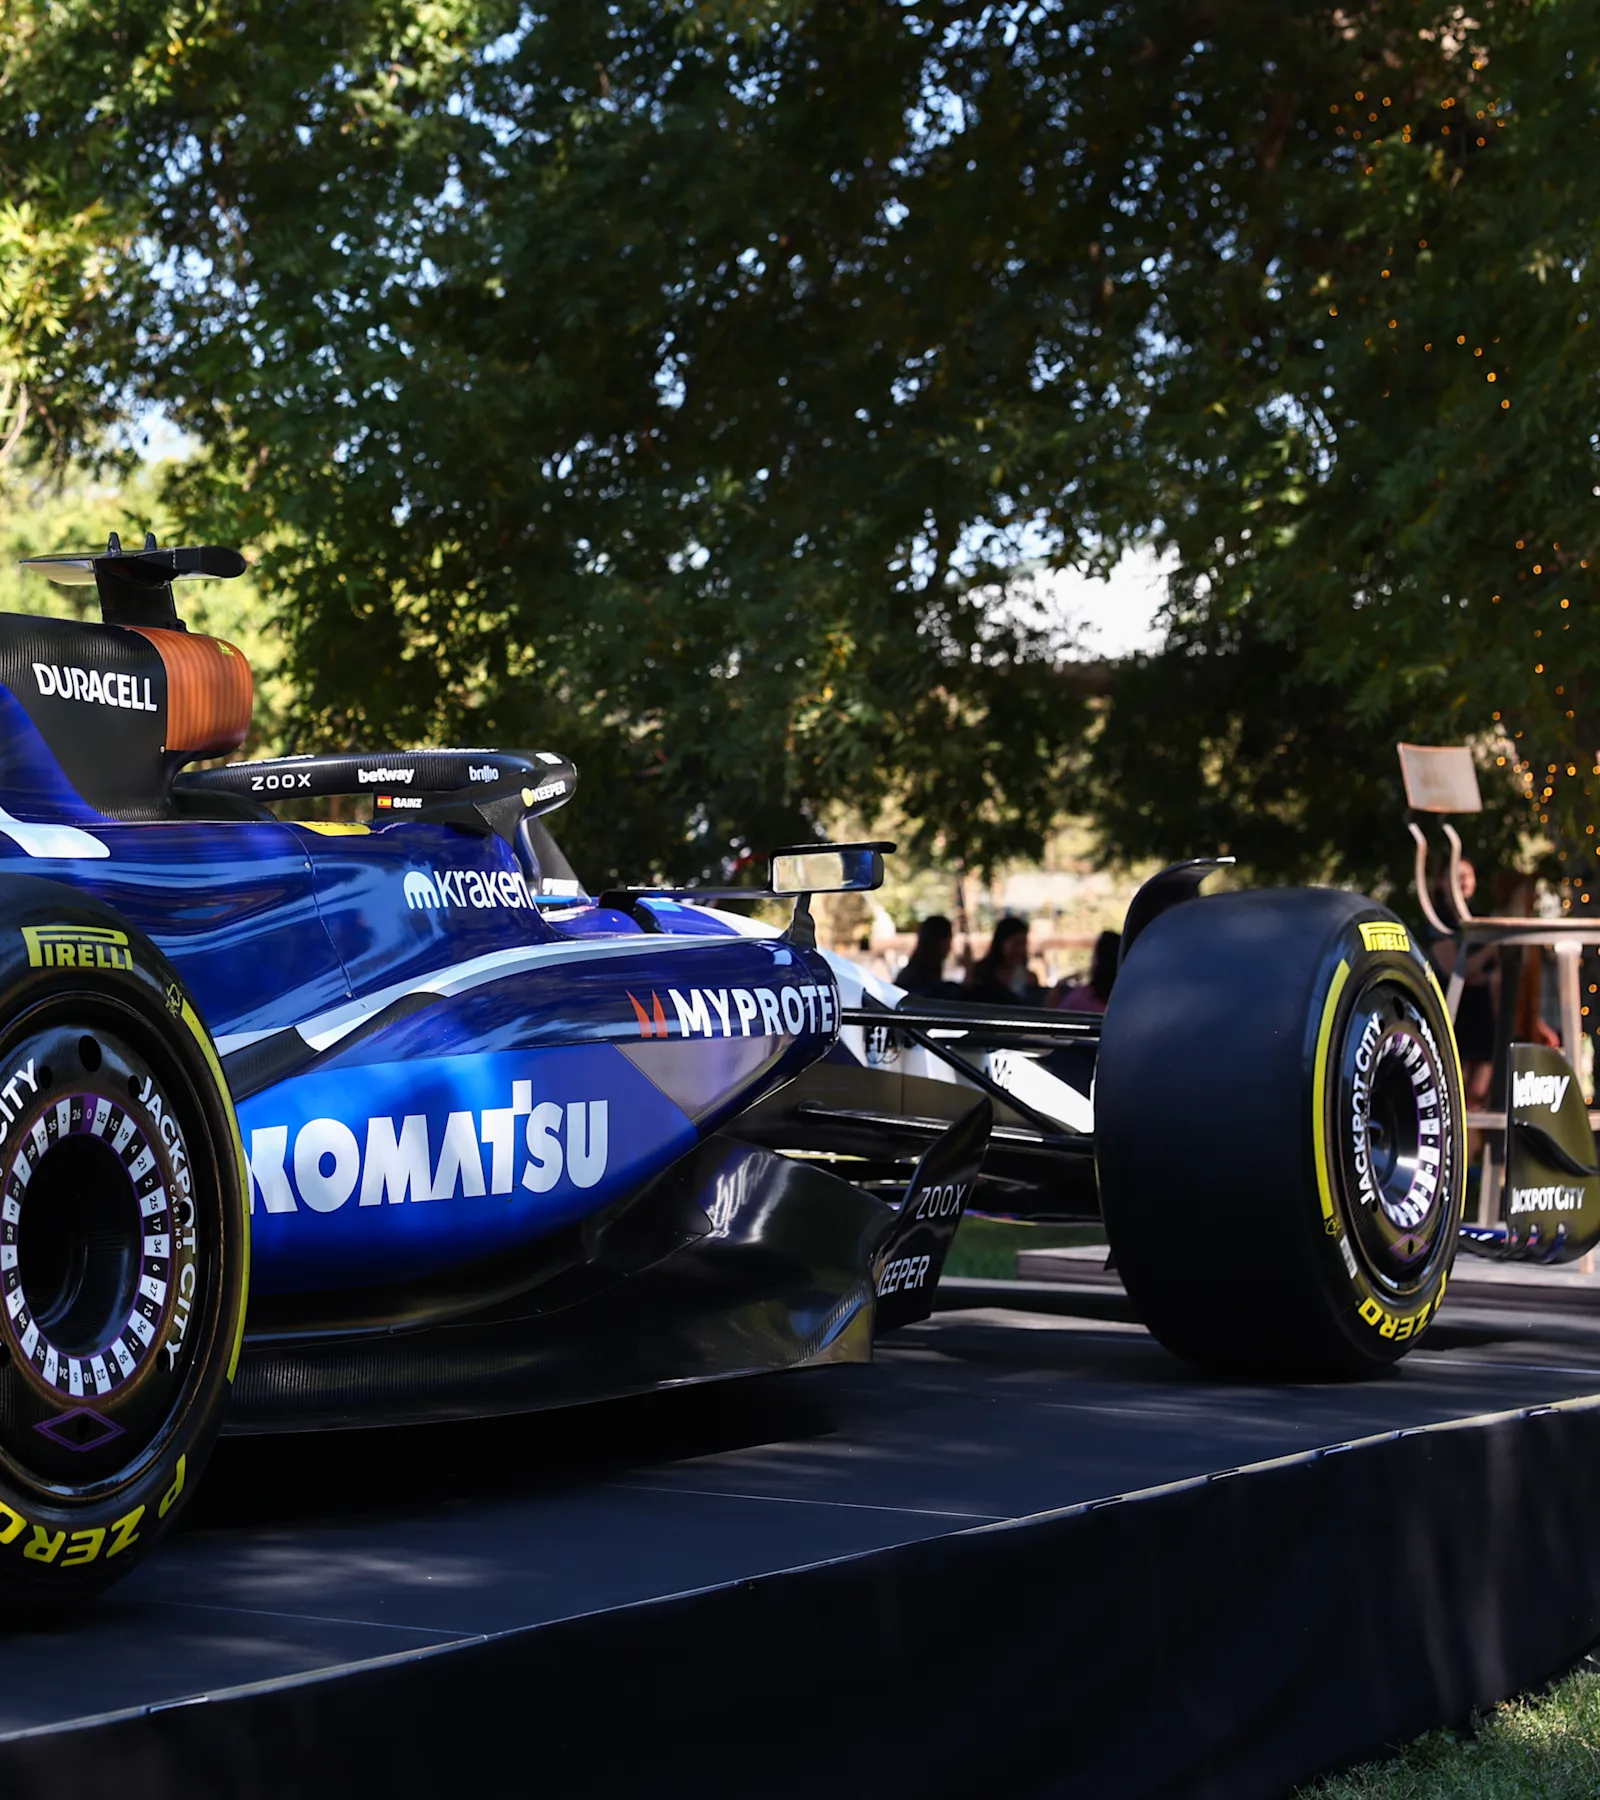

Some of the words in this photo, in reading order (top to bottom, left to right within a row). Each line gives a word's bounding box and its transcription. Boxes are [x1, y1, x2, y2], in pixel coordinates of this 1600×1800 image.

[32, 662, 157, 712] DURACELL
[251, 773, 311, 791] ZOOX
[358, 768, 415, 784] betway
[532, 780, 566, 803] KEEPER
[393, 797, 422, 808] SAINZ
[433, 870, 537, 912] kraken
[1358, 921, 1410, 952] PIRELLI
[21, 925, 133, 971] PIRELLI
[1355, 1012, 1381, 1073] CITY
[62, 1113, 67, 1124] 3
[72, 1109, 82, 1121] 26
[86, 1108, 92, 1120] 0
[96, 1111, 107, 1124] 32
[47, 1119, 58, 1134] 35
[109, 1117, 119, 1132] 15
[37, 1132, 46, 1144] 12
[120, 1128, 129, 1141] 19
[1352, 1073, 1376, 1206] JACKPOT
[27, 1144, 36, 1160] 28
[131, 1143, 138, 1154] 4
[243, 1079, 609, 1215] KOMATSU
[137, 1157, 147, 1171] 21
[138, 1076, 196, 1254] JACKPOT
[145, 1178, 153, 1188] 2
[149, 1195, 158, 1211] 25
[916, 1184, 966, 1220] ZOOX
[152, 1217, 162, 1232] 17
[6, 1225, 15, 1241] 22
[153, 1239, 162, 1253] 34
[152, 1263, 161, 1272] 6
[877, 1255, 930, 1298] KEEPER
[150, 1283, 158, 1298] 27
[143, 1302, 154, 1318] 13
[166, 1262, 196, 1372] CITY
[1358, 1297, 1432, 1341] ZERO
[137, 1320, 147, 1335] 36
[128, 1336, 139, 1351] 11
[36, 1345, 46, 1361] 33
[119, 1350, 129, 1365] 30
[59, 1367, 69, 1380] 24
[96, 1368, 106, 1381] 23
[109, 1361, 116, 1374] 8
[74, 1372, 79, 1383] 5
[83, 1371, 93, 1384] 10
[158, 1453, 186, 1519] P
